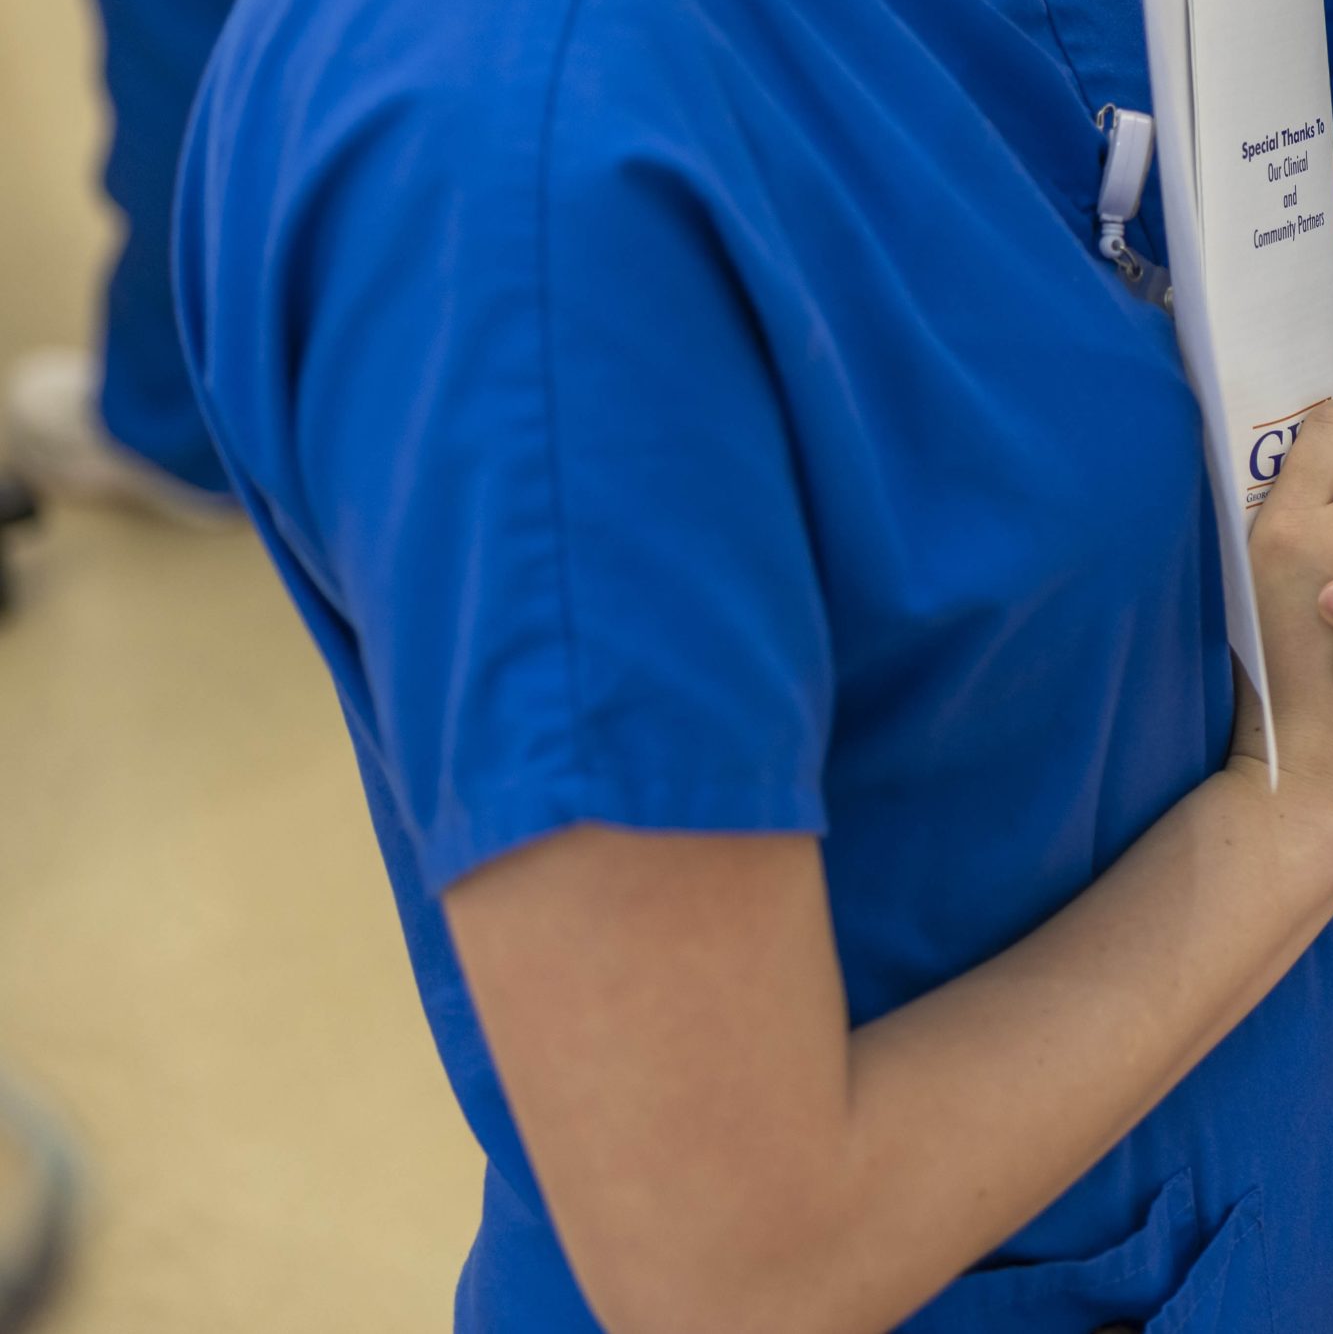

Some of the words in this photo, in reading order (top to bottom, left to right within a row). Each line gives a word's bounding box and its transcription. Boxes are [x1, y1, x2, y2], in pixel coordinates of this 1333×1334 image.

[1242, 131, 1279, 161] Special
[1281, 122, 1315, 147] Thanks
[1316, 118, 1325, 135] To
[1268, 163, 1282, 182] Our
[1283, 150, 1309, 177] Clinical
[1283, 184, 1297, 208] and
[1253, 219, 1297, 248] Community
[1297, 211, 1325, 234] Partners
